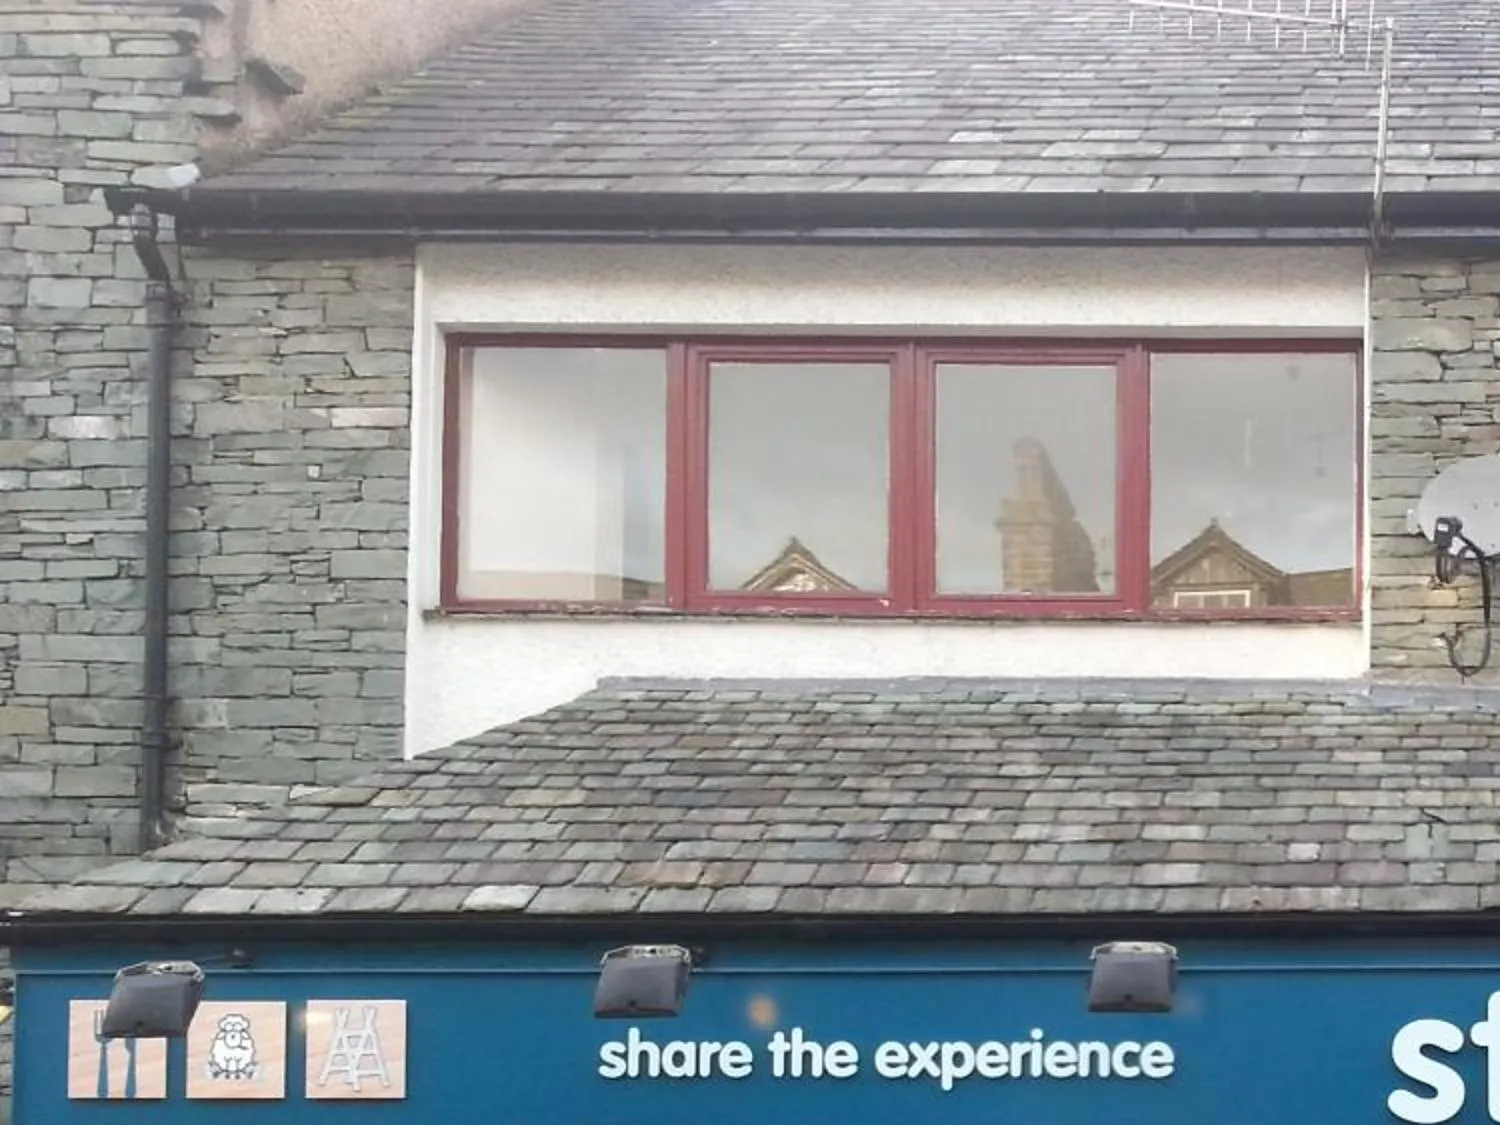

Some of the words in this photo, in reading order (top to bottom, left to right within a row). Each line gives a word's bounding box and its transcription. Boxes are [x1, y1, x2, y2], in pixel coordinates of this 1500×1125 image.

[599, 1027, 753, 1078] share
[767, 1027, 859, 1078] the
[874, 1028, 1175, 1091] experience
